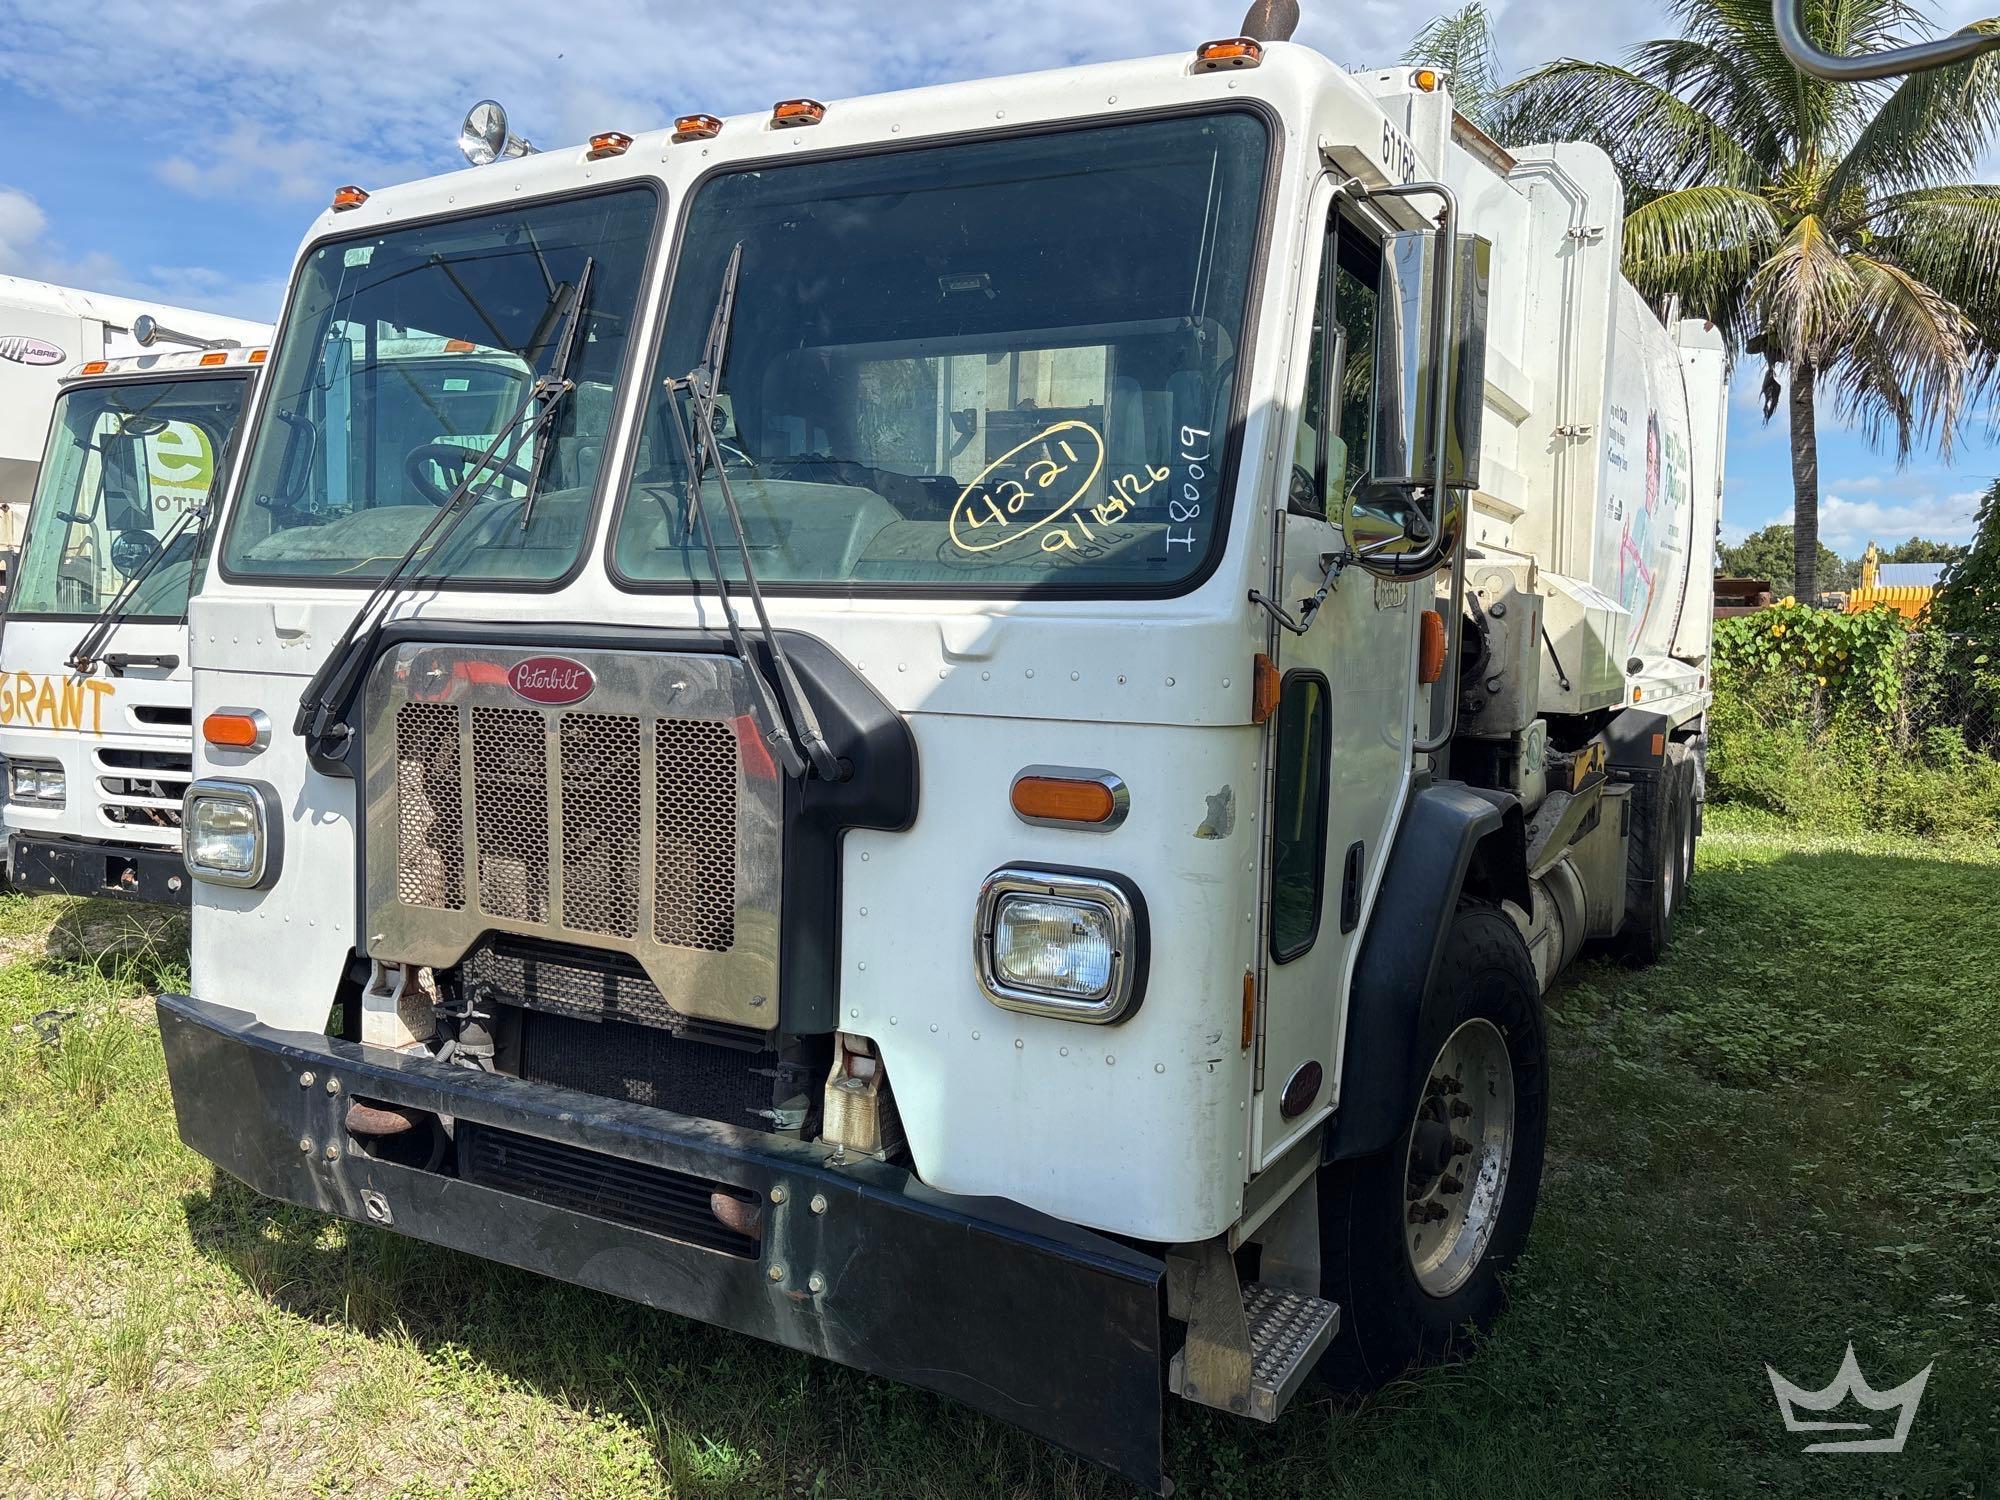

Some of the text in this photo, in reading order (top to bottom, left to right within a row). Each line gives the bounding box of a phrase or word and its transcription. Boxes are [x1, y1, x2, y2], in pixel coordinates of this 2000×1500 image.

[1382, 119, 1416, 185] 61168
[25, 348, 58, 359] LABRIE
[966, 440, 1079, 527] 4221
[0, 669, 116, 738] GRANT
[517, 664, 586, 690] Peterbilt
